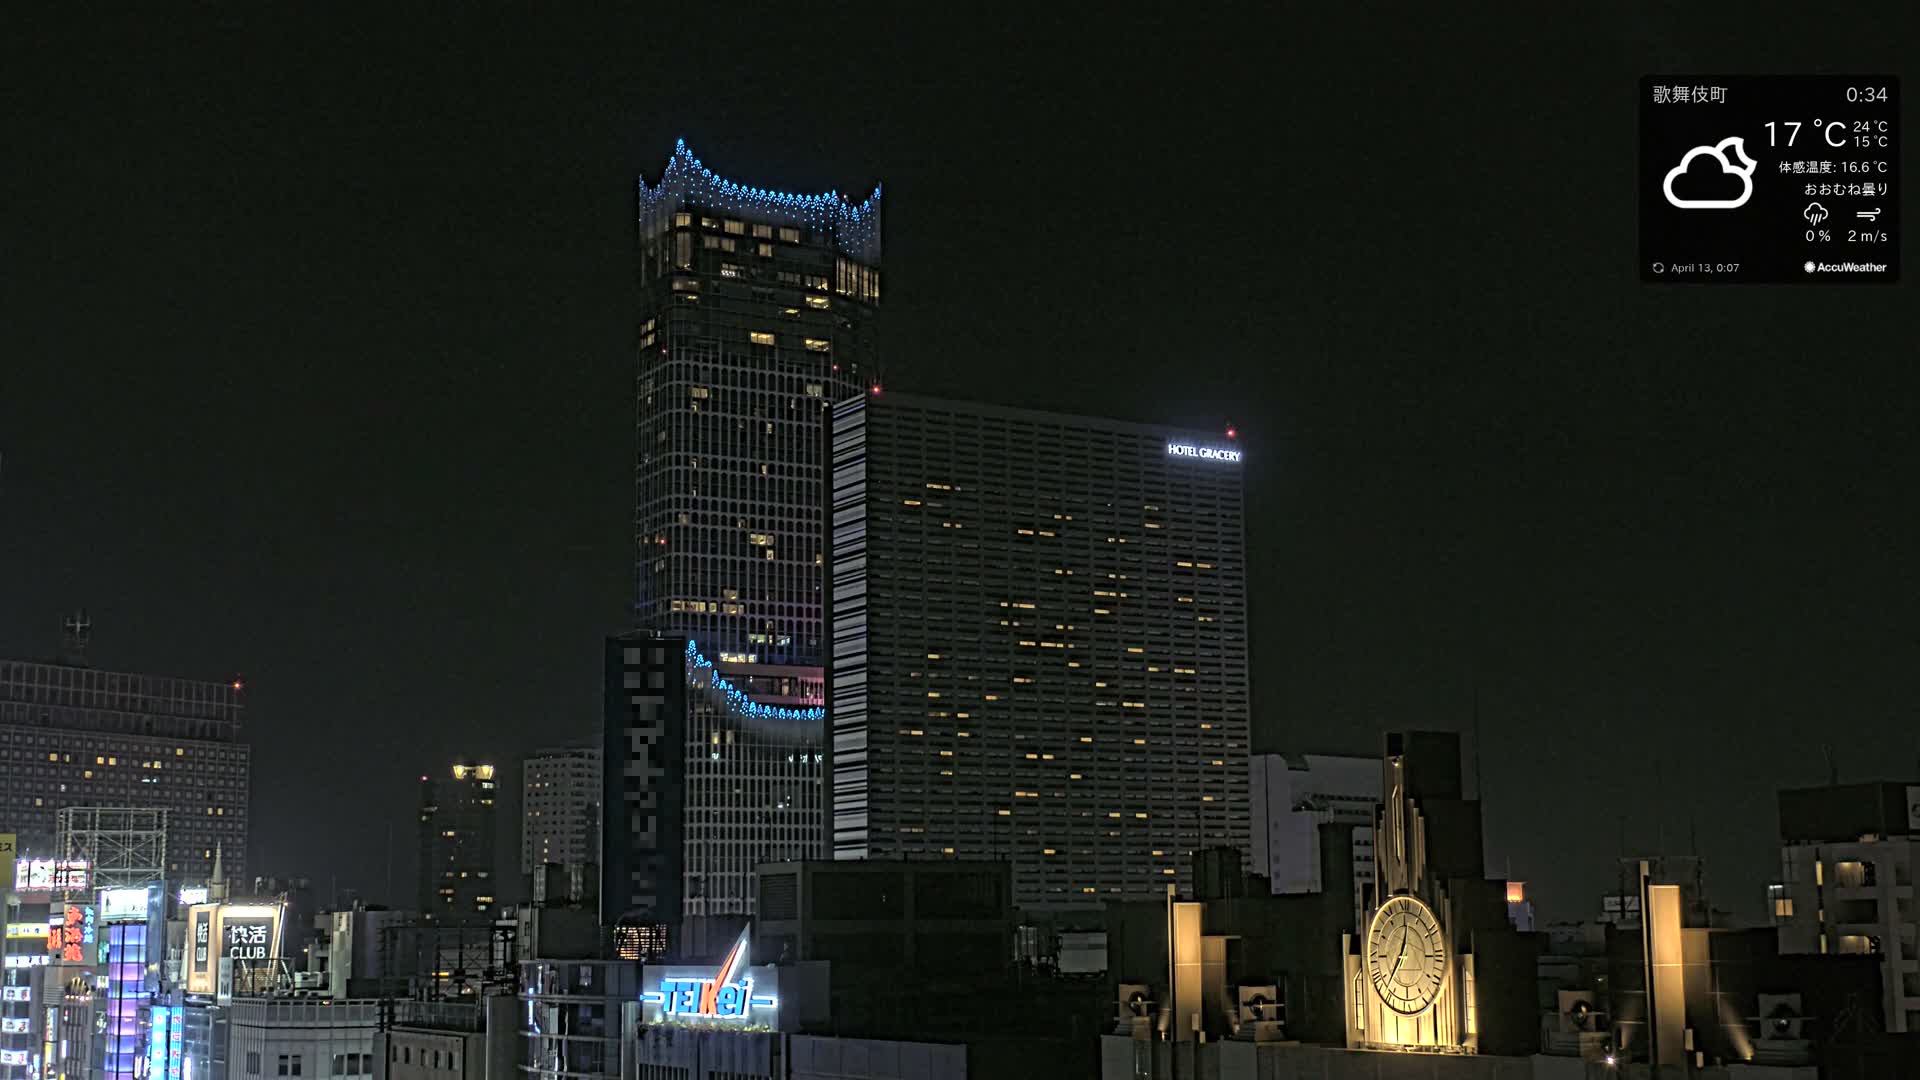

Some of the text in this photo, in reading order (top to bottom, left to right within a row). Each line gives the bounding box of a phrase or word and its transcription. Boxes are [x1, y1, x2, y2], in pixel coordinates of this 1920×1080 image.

[1168, 443, 1241, 462] HOTEL GRACERY
[231, 925, 266, 944] 快活
[230, 946, 266, 960] CLUB
